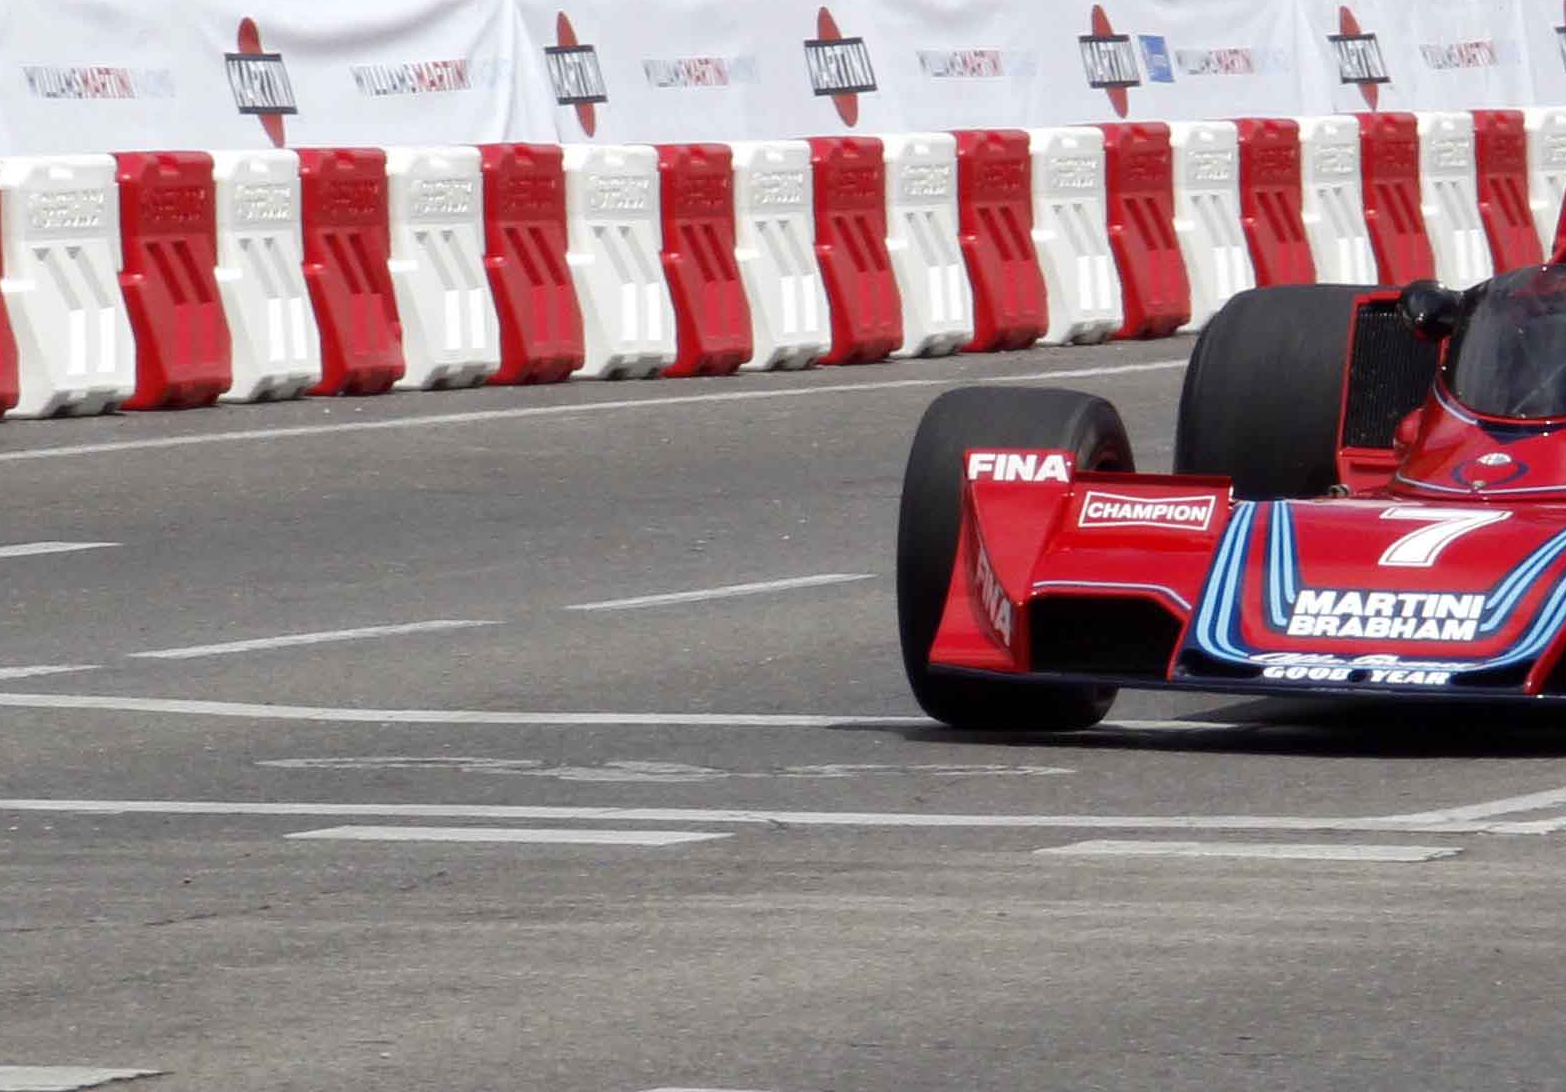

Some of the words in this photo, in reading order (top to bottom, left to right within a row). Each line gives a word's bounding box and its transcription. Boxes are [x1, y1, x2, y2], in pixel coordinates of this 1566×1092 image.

[968, 453, 1069, 483] FINA
[1087, 502, 1207, 521] CHAMPION
[1378, 507, 1514, 567] 7
[1293, 589, 1485, 620] MARTINI
[1286, 614, 1478, 641] BRABHAM
[1263, 666, 1352, 680] GOOD
[1369, 670, 1451, 685] YEAR
